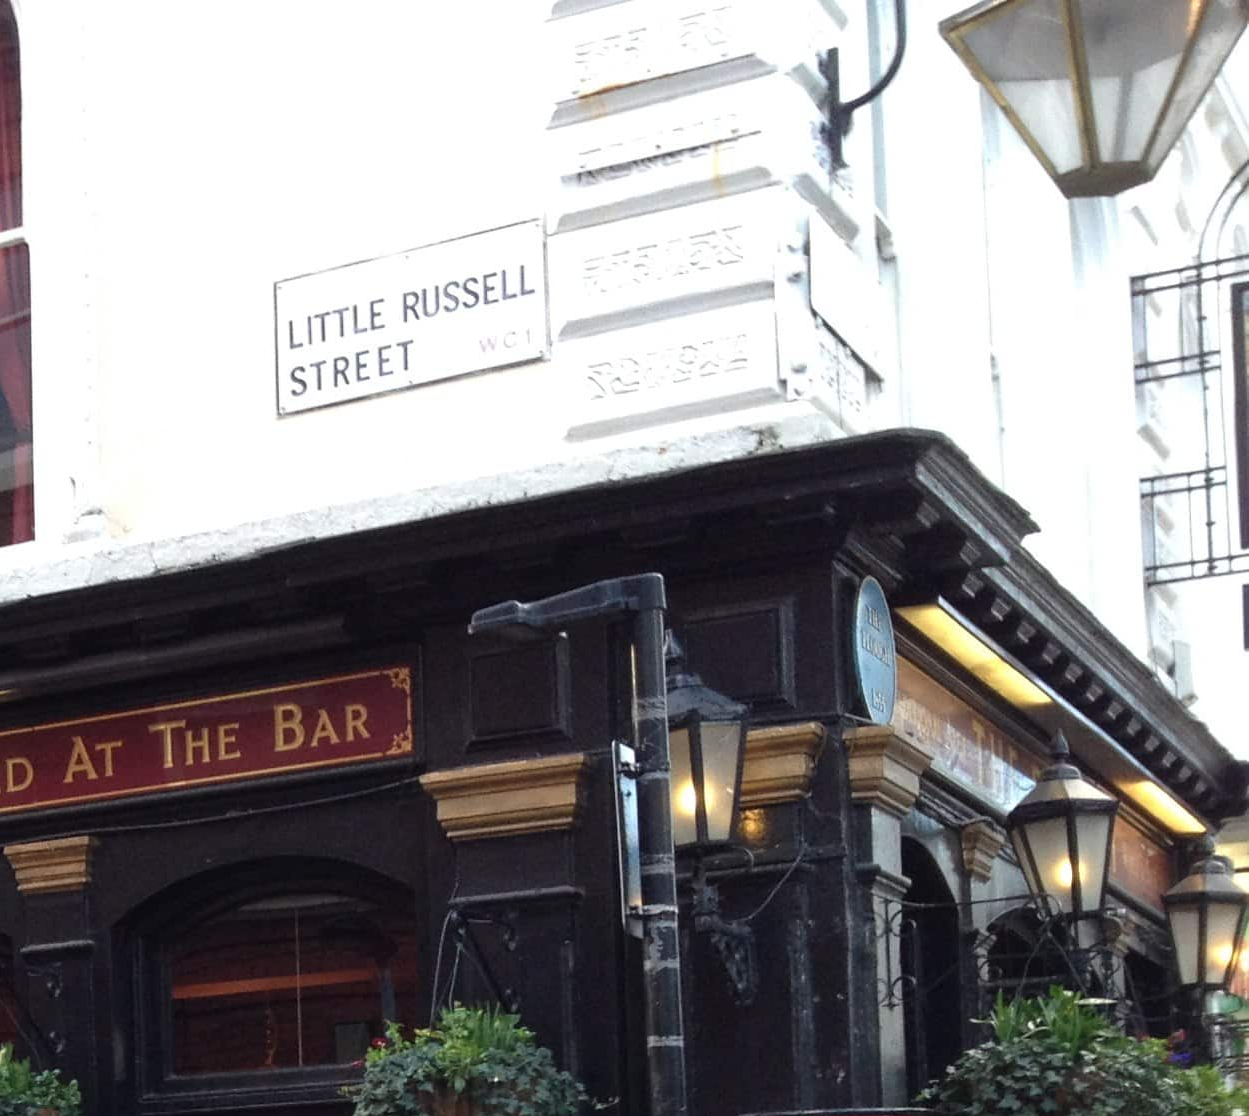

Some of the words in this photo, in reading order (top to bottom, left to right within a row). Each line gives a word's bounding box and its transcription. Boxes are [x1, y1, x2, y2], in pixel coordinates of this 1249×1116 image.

[288, 298, 386, 349] LITTLE
[402, 264, 536, 324] RUSSELL
[289, 339, 415, 398] STREET
[62, 736, 123, 783] AT
[149, 716, 241, 769] THE
[273, 702, 371, 753] BAR
